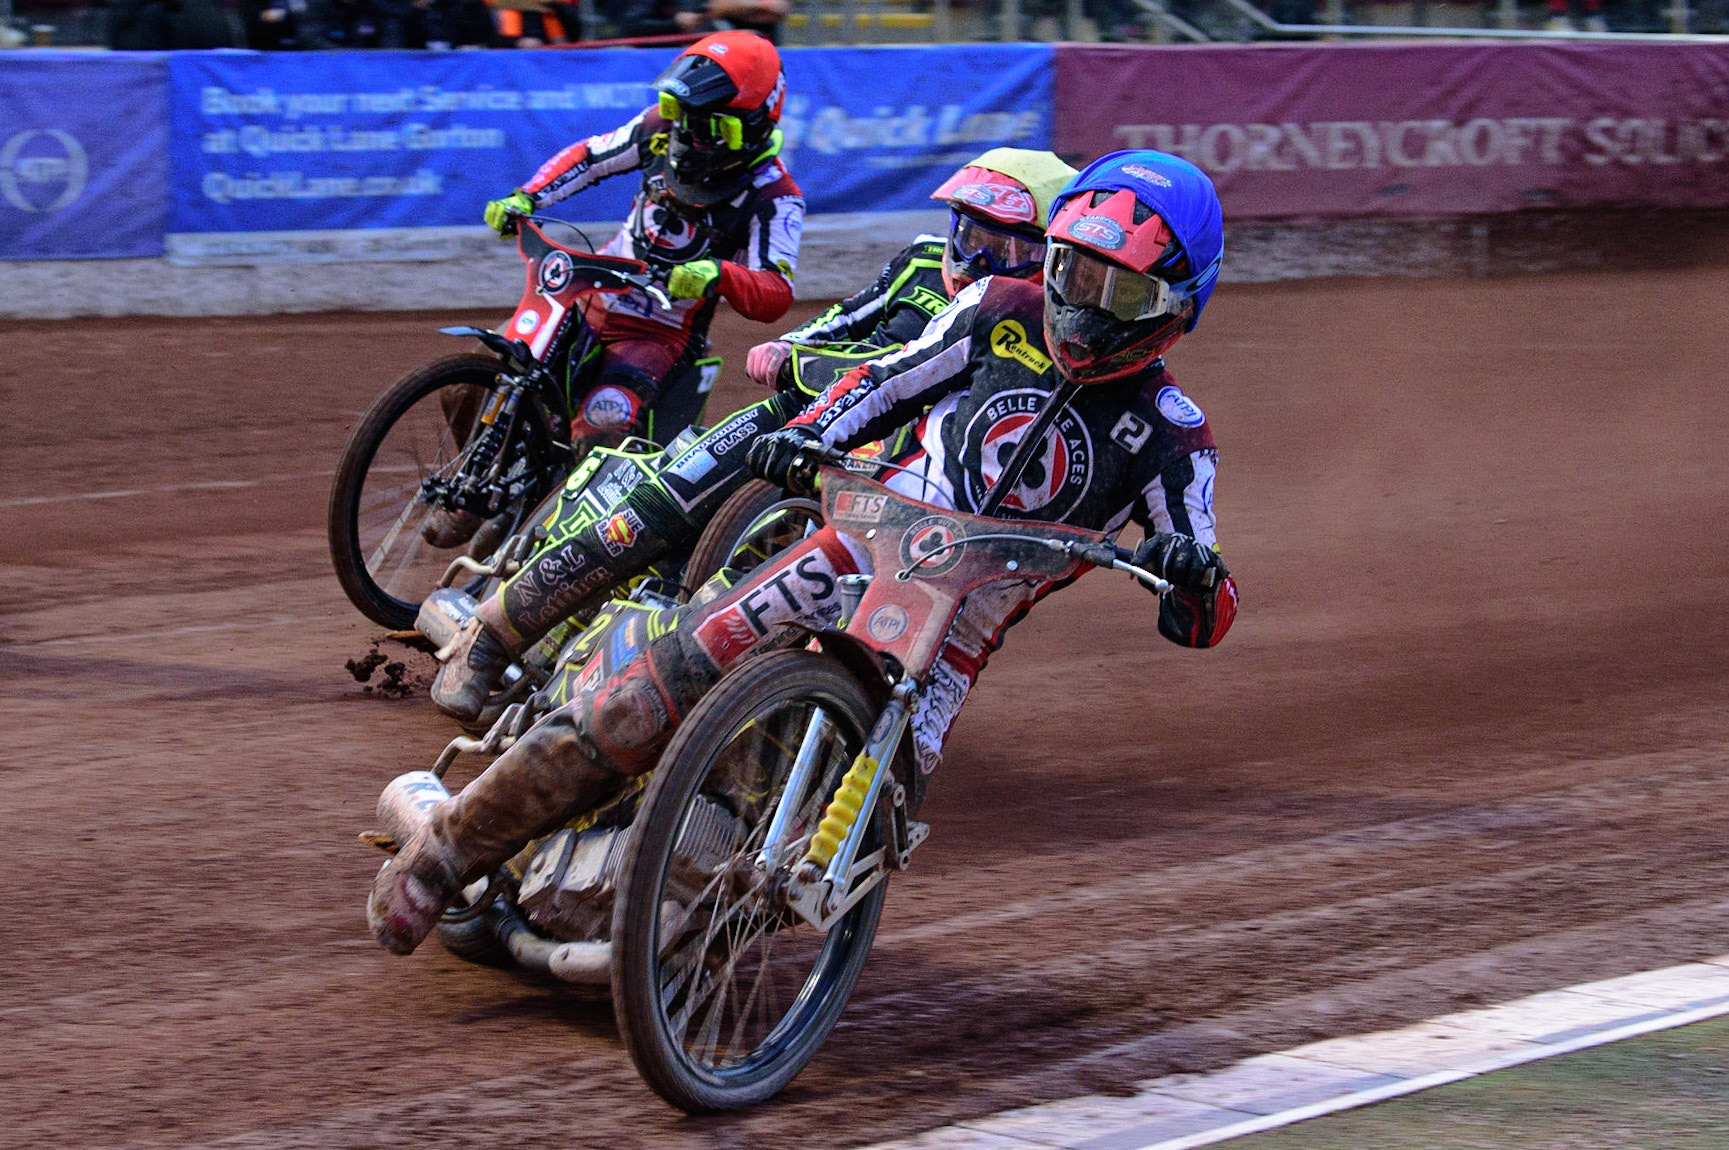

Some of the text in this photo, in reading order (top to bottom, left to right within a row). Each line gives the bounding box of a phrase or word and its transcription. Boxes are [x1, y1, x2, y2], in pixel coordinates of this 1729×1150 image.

[1077, 222, 1118, 240] STS
[995, 324, 1047, 370] Rentruck
[986, 396, 1038, 421] BELLE
[713, 421, 758, 456] GLASS
[1068, 438, 1086, 486] ACES
[851, 494, 885, 513] FTS
[622, 509, 642, 533] SUE
[739, 555, 834, 637] FTS
